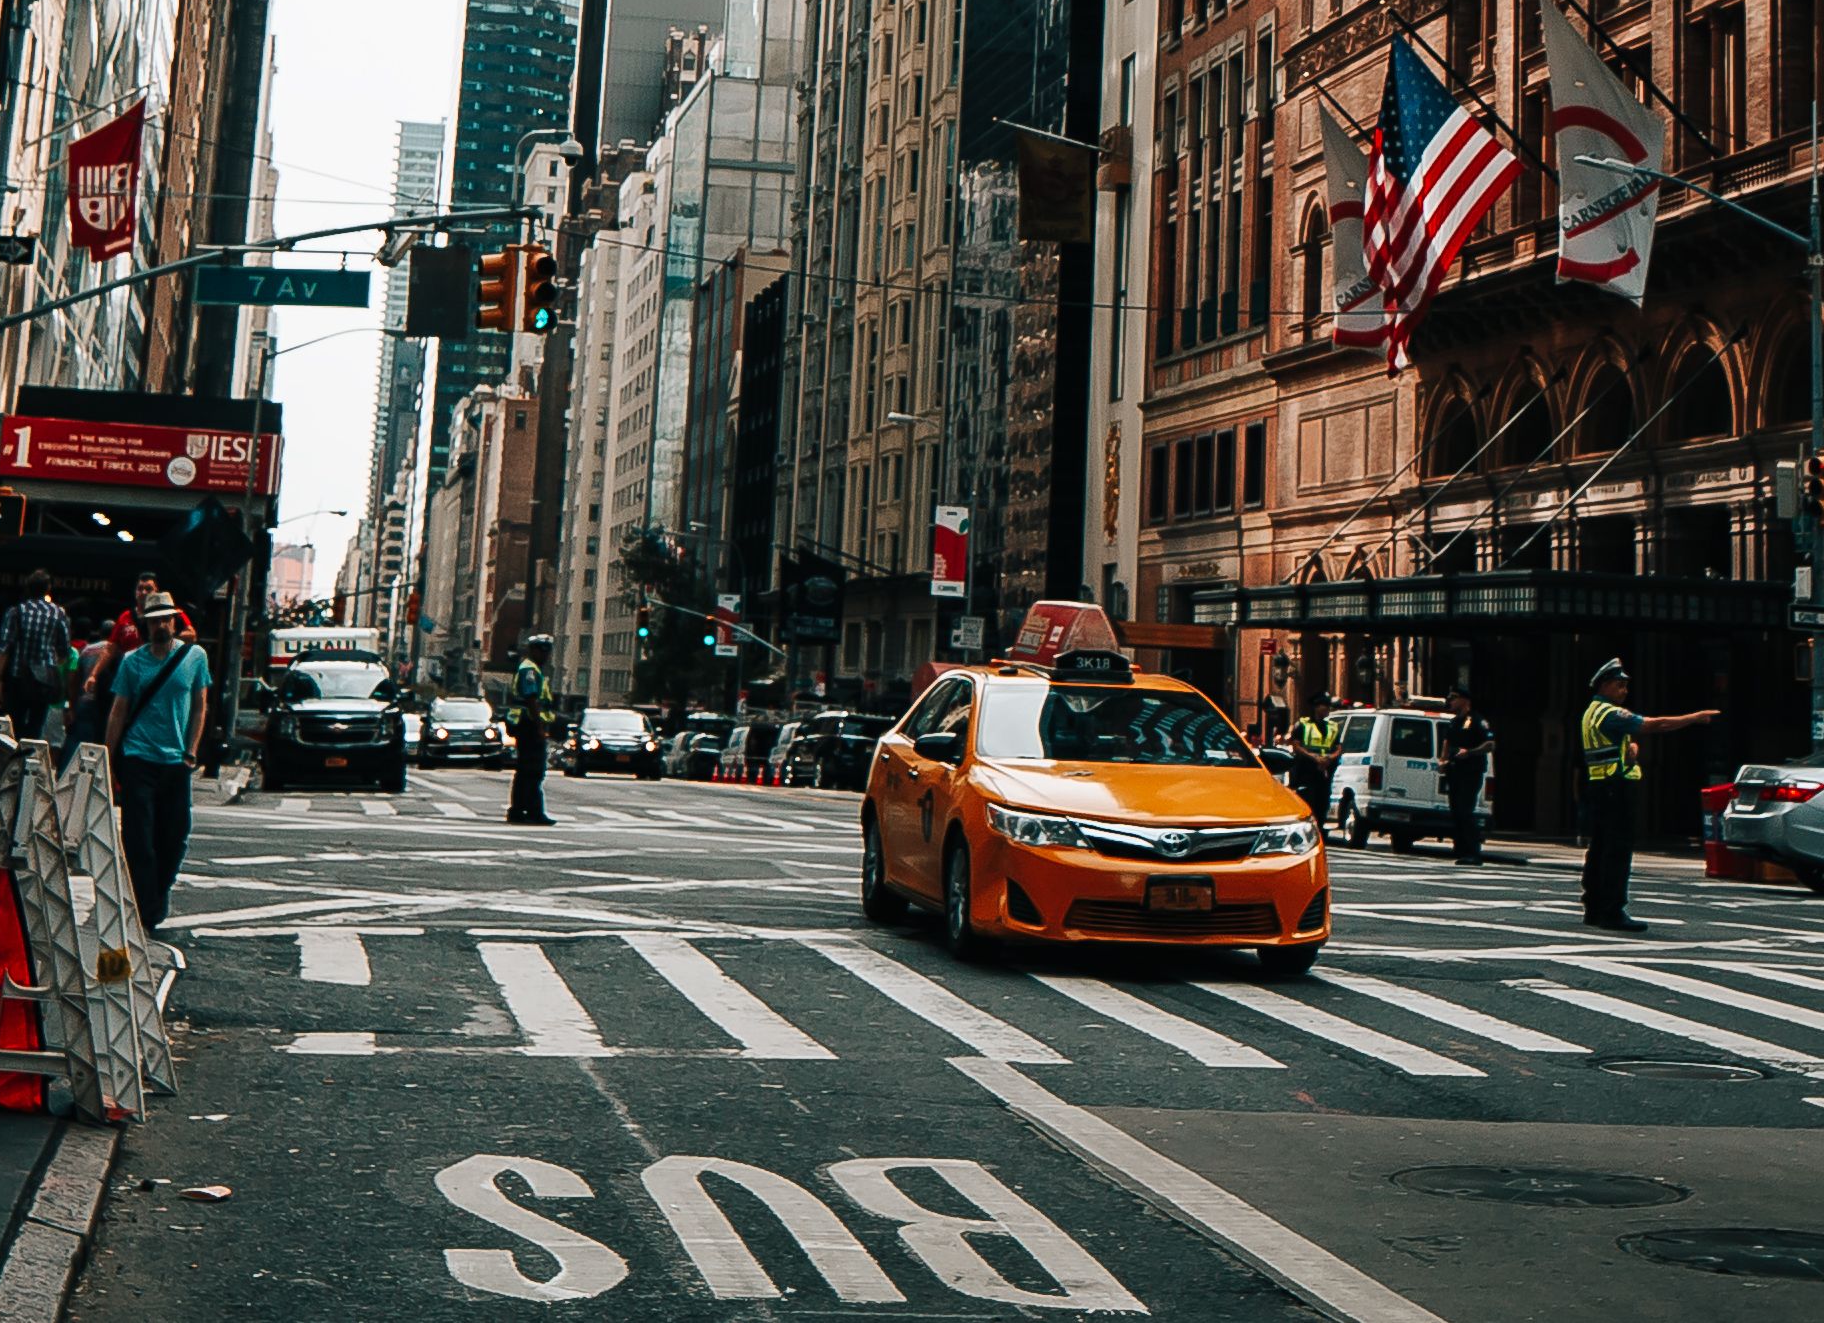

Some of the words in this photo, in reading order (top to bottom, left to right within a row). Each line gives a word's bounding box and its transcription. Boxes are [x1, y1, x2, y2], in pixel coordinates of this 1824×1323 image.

[248, 275, 265, 297] 7
[276, 275, 318, 299] Av
[1336, 275, 1377, 309] CARN
[1075, 656, 1111, 670] 3K18
[434, 1153, 1151, 1315] BUS
